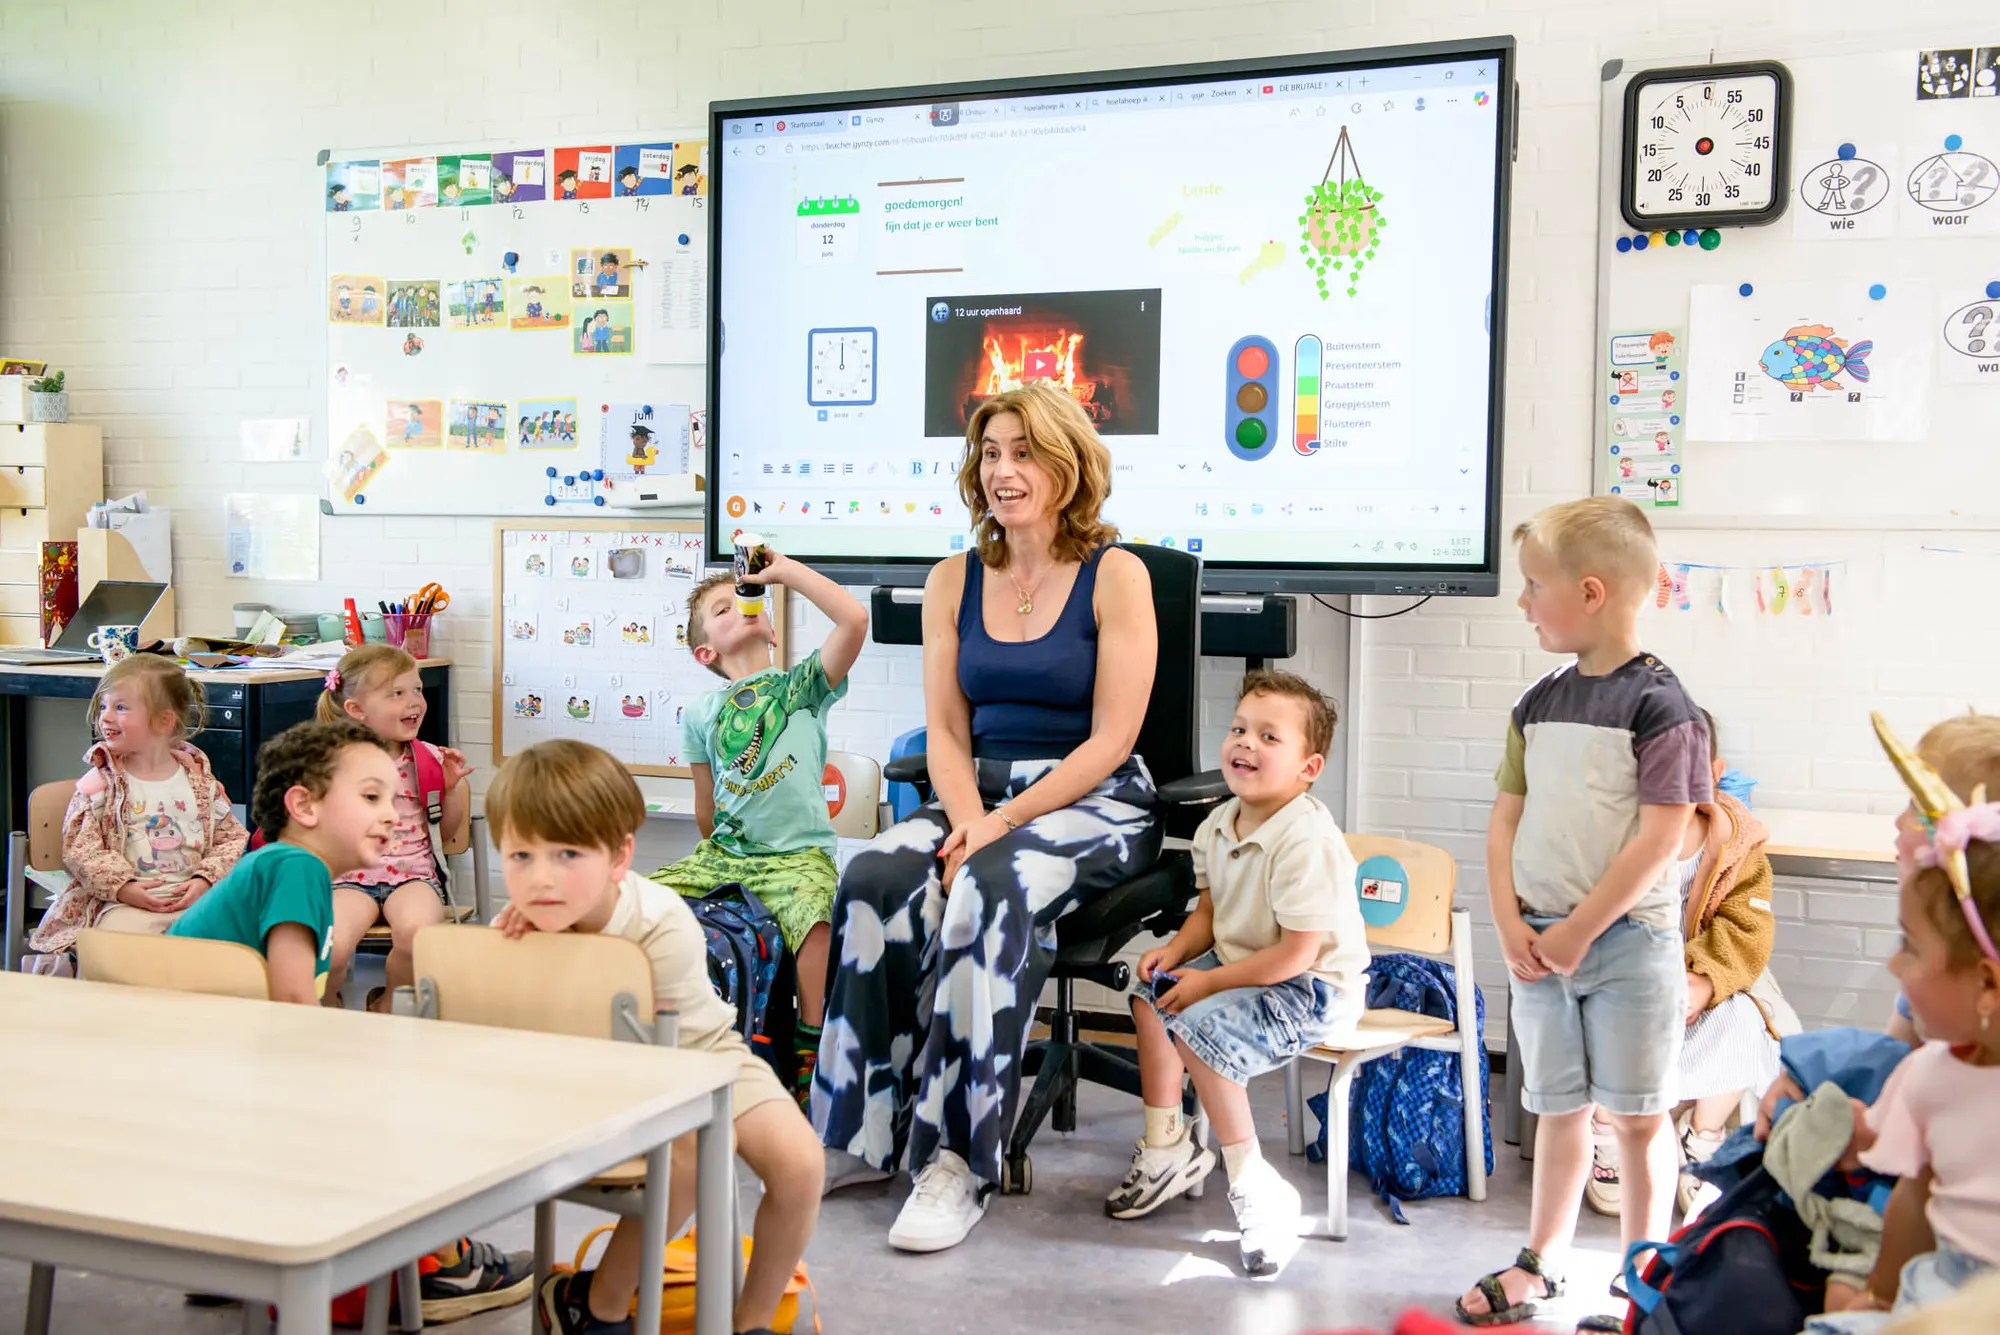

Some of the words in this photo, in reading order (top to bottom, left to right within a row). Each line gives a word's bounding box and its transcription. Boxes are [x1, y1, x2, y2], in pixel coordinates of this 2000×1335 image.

[1291, 81, 1323, 91] BRUTALE
[1211, 89, 1237, 98] Zoeken
[1704, 86, 1711, 99] 0
[1727, 90, 1742, 104] 55
[1676, 96, 1684, 109] 5
[866, 116, 885, 125] Gynzy
[1748, 108, 1763, 122] 50
[790, 120, 825, 130] Startportaal
[1650, 116, 1664, 129] 10
[1754, 136, 1770, 149] 45
[1642, 144, 1656, 157] 15
[642, 152, 670, 162] zaterdag
[514, 158, 544, 168] donderdag
[1744, 163, 1760, 176] 40
[1648, 169, 1662, 182] 20
[1668, 188, 1683, 201] 25
[1724, 185, 1740, 198] 35
[634, 198, 650, 212] 14
[692, 198, 703, 208] 15
[884, 196, 963, 213] goedemorgen!
[1695, 193, 1711, 206] 30
[512, 205, 525, 220] 12
[579, 201, 590, 214] 13
[406, 214, 416, 224] 10
[461, 210, 470, 221] 11
[1933, 214, 1970, 226] waar
[810, 220, 845, 230] donderdag
[885, 221, 900, 234] fijn
[903, 220, 920, 230] dat
[922, 220, 931, 232] je
[935, 220, 945, 229] er
[947, 219, 972, 228] weer
[975, 215, 998, 227] bent
[1830, 217, 1855, 230] wie
[822, 234, 834, 244] 12
[955, 307, 965, 317] 12
[966, 308, 978, 316] uur
[980, 306, 1022, 318] openhaard
[1326, 342, 1380, 351] Buitenstem
[1325, 361, 1401, 370] Presenteerstem
[1325, 381, 1374, 390] Praatstem
[1324, 400, 1390, 411] Groepjesstem
[1324, 420, 1371, 428] Fluisteren
[1324, 439, 1348, 448] Stilte
[1778, 586, 1785, 597] 7
[505, 674, 511, 684] 6
[565, 676, 571, 686] 6
[611, 676, 617, 686] 6
[724, 754, 798, 797] DINO-PARTY!
